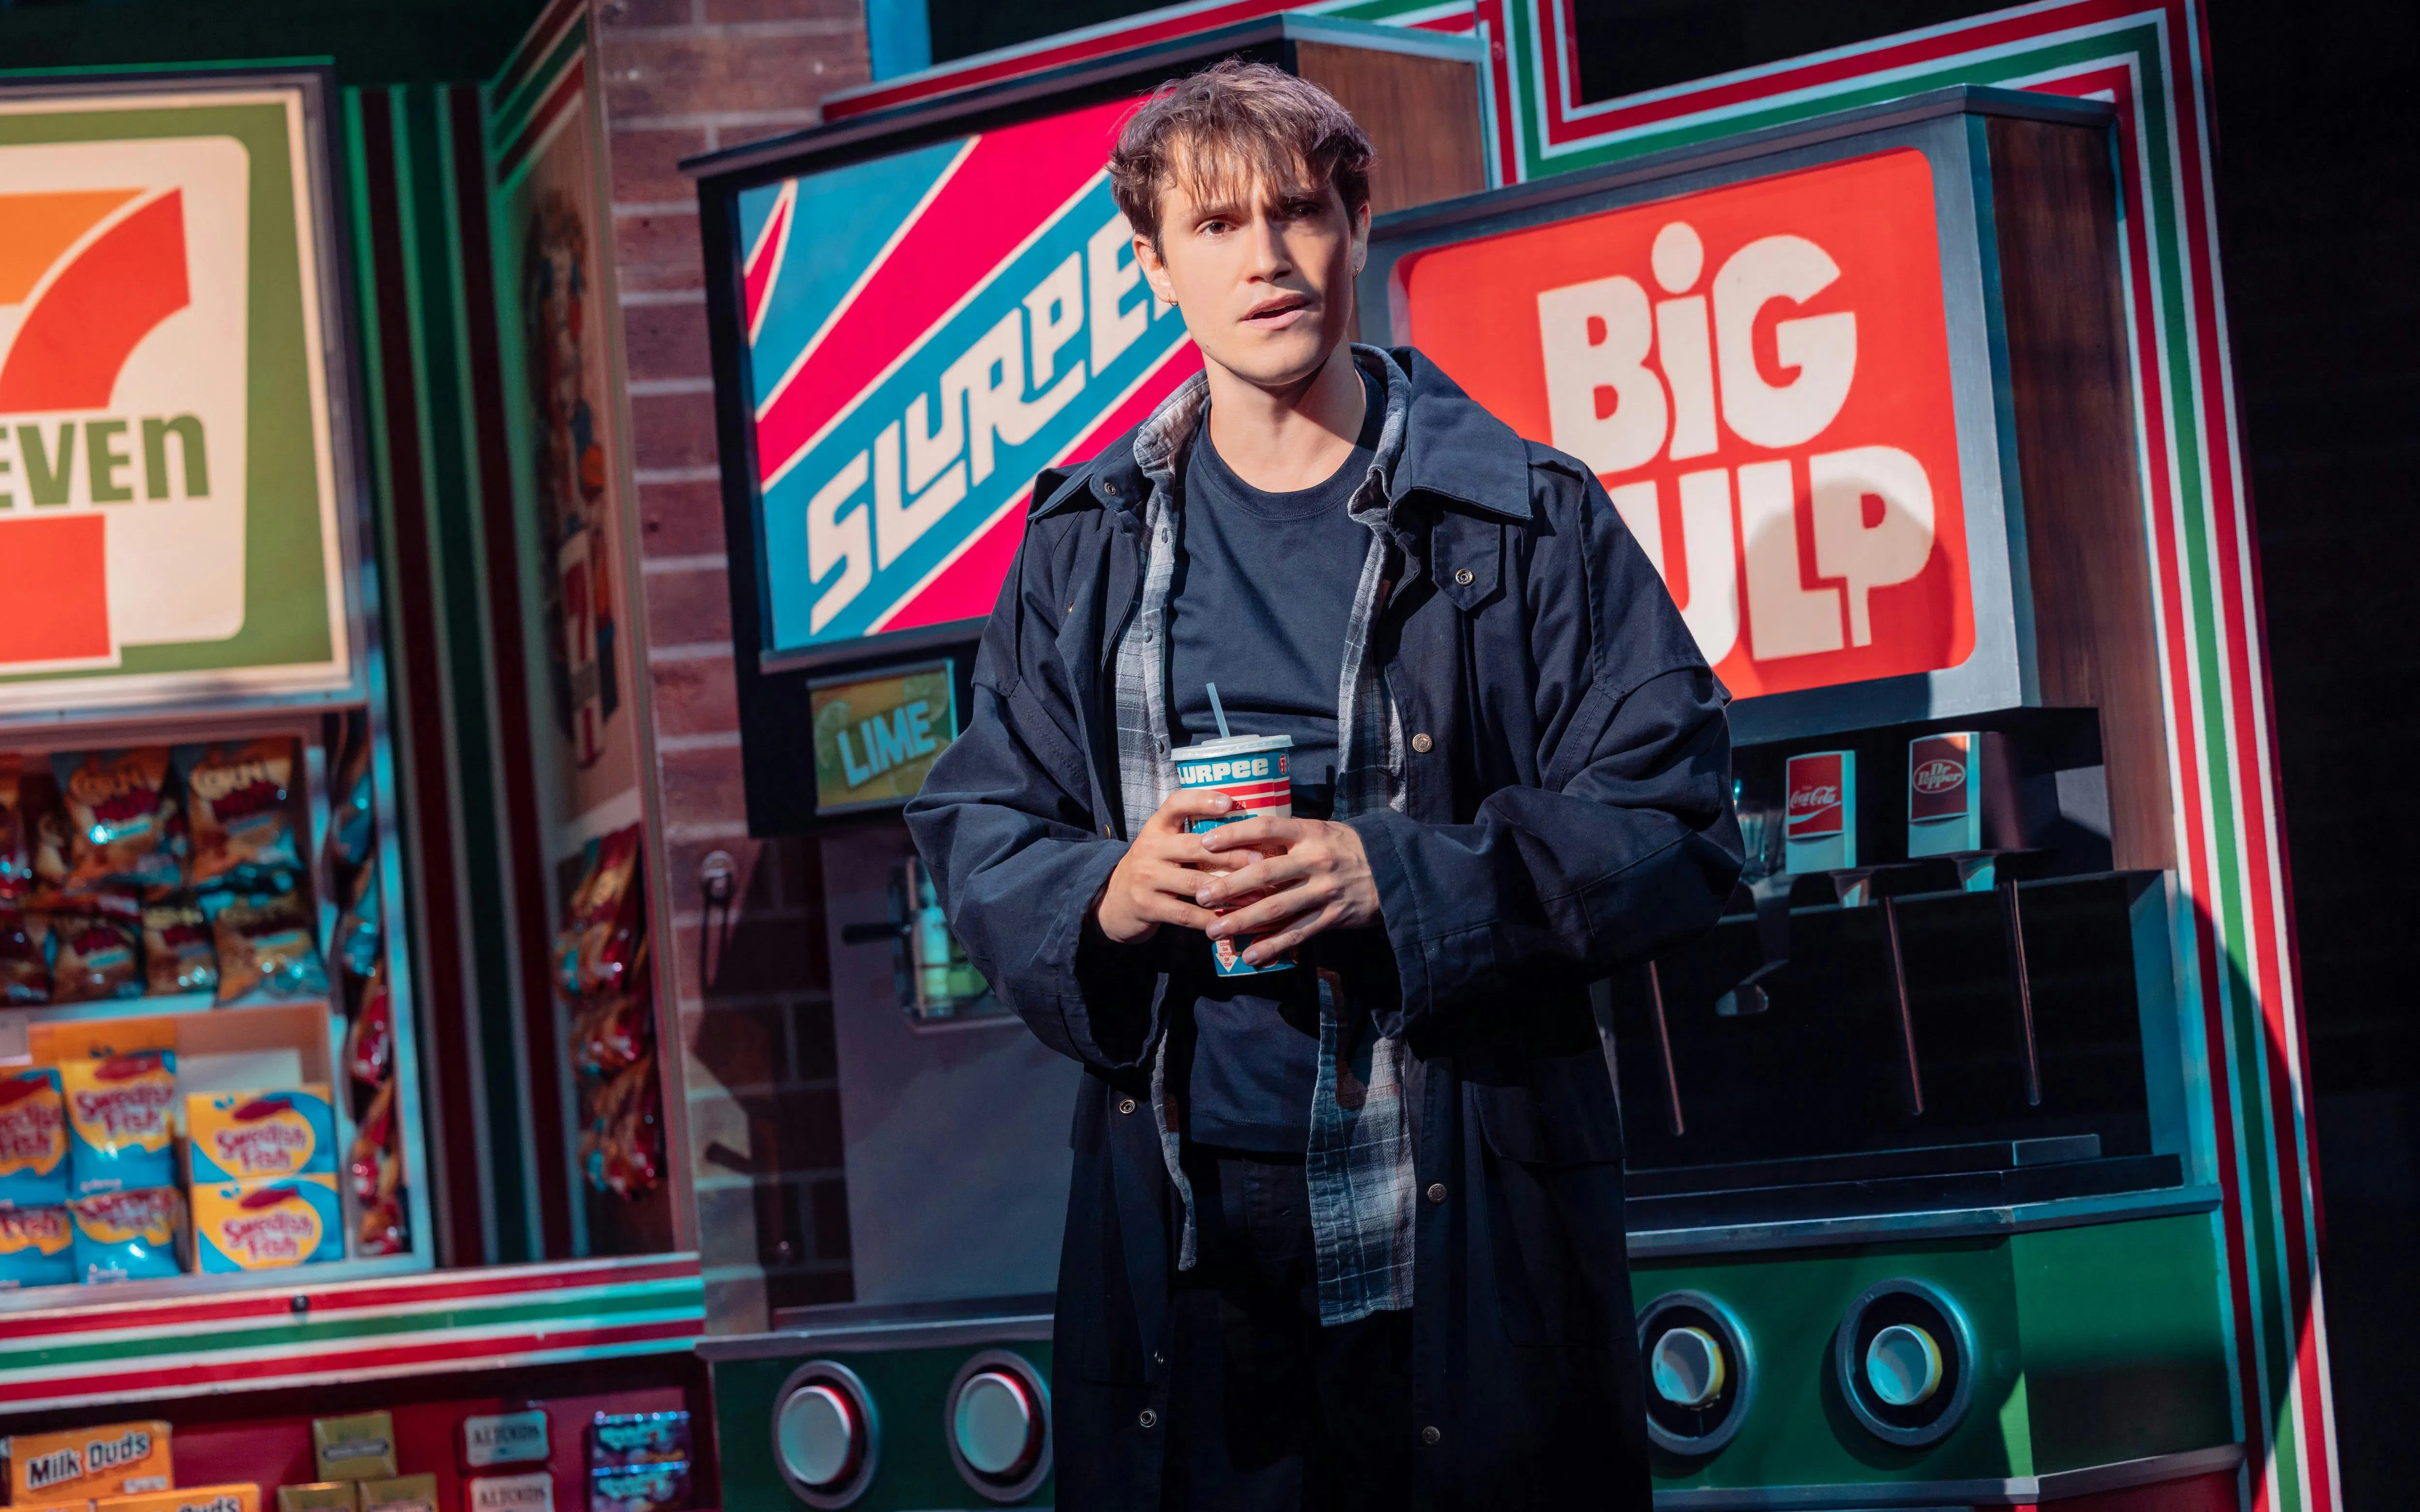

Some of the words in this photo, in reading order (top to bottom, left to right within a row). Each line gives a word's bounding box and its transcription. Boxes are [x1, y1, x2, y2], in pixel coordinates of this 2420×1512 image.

[807, 213, 1177, 636] SLURPE
[1609, 445, 1935, 668] ULP
[837, 700, 937, 789] LIME
[1918, 771, 1962, 790] Pepper
[1930, 763, 1951, 775] Dr
[1236, 800, 1247, 809] 24
[216, 1123, 307, 1159] Swedish
[241, 1149, 291, 1172] Fish
[223, 1212, 315, 1247] Swedish
[247, 1236, 298, 1259] Fish
[28, 1449, 82, 1488] Milk
[87, 1432, 151, 1471] Duds
